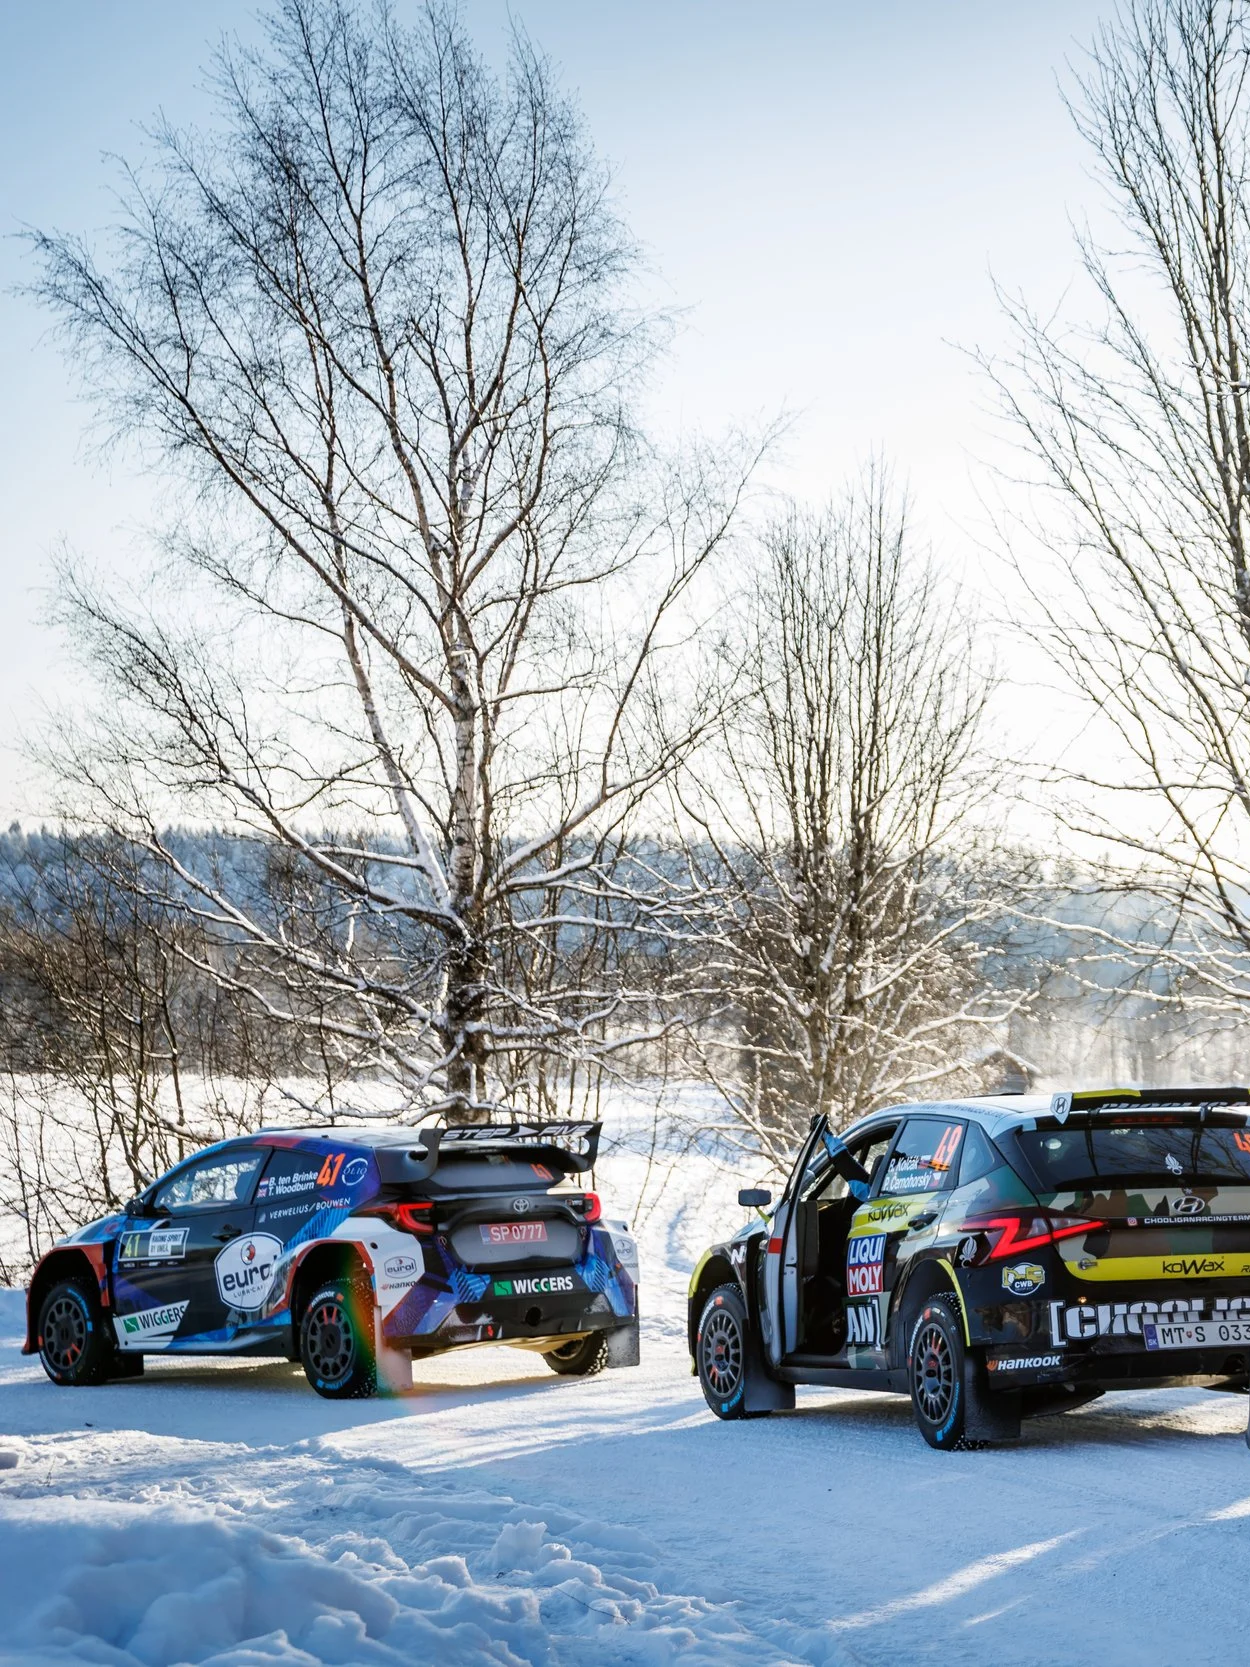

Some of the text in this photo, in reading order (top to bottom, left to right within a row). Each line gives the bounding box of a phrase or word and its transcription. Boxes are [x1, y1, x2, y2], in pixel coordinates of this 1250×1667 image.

[440, 1124, 594, 1140] STEP FIVE
[932, 1125, 963, 1172] 49
[268, 1171, 319, 1187] B. ten Brinke
[316, 1153, 346, 1187] 41
[529, 1163, 555, 1181] 41
[268, 1181, 315, 1197] T. Woodburn
[490, 1223, 544, 1242] SP 0777
[125, 1233, 141, 1258] 41
[849, 1236, 885, 1265] LIQUI
[223, 1255, 279, 1291] euro
[386, 1262, 415, 1274] eurol
[1162, 1258, 1225, 1275] koWax
[513, 1276, 574, 1295] WIGGERS
[849, 1265, 882, 1293] MOLY
[1015, 1280, 1034, 1289] CWB
[138, 1305, 186, 1329] WIGGERS
[1161, 1327, 1185, 1345] MT
[1194, 1325, 1206, 1343] S
